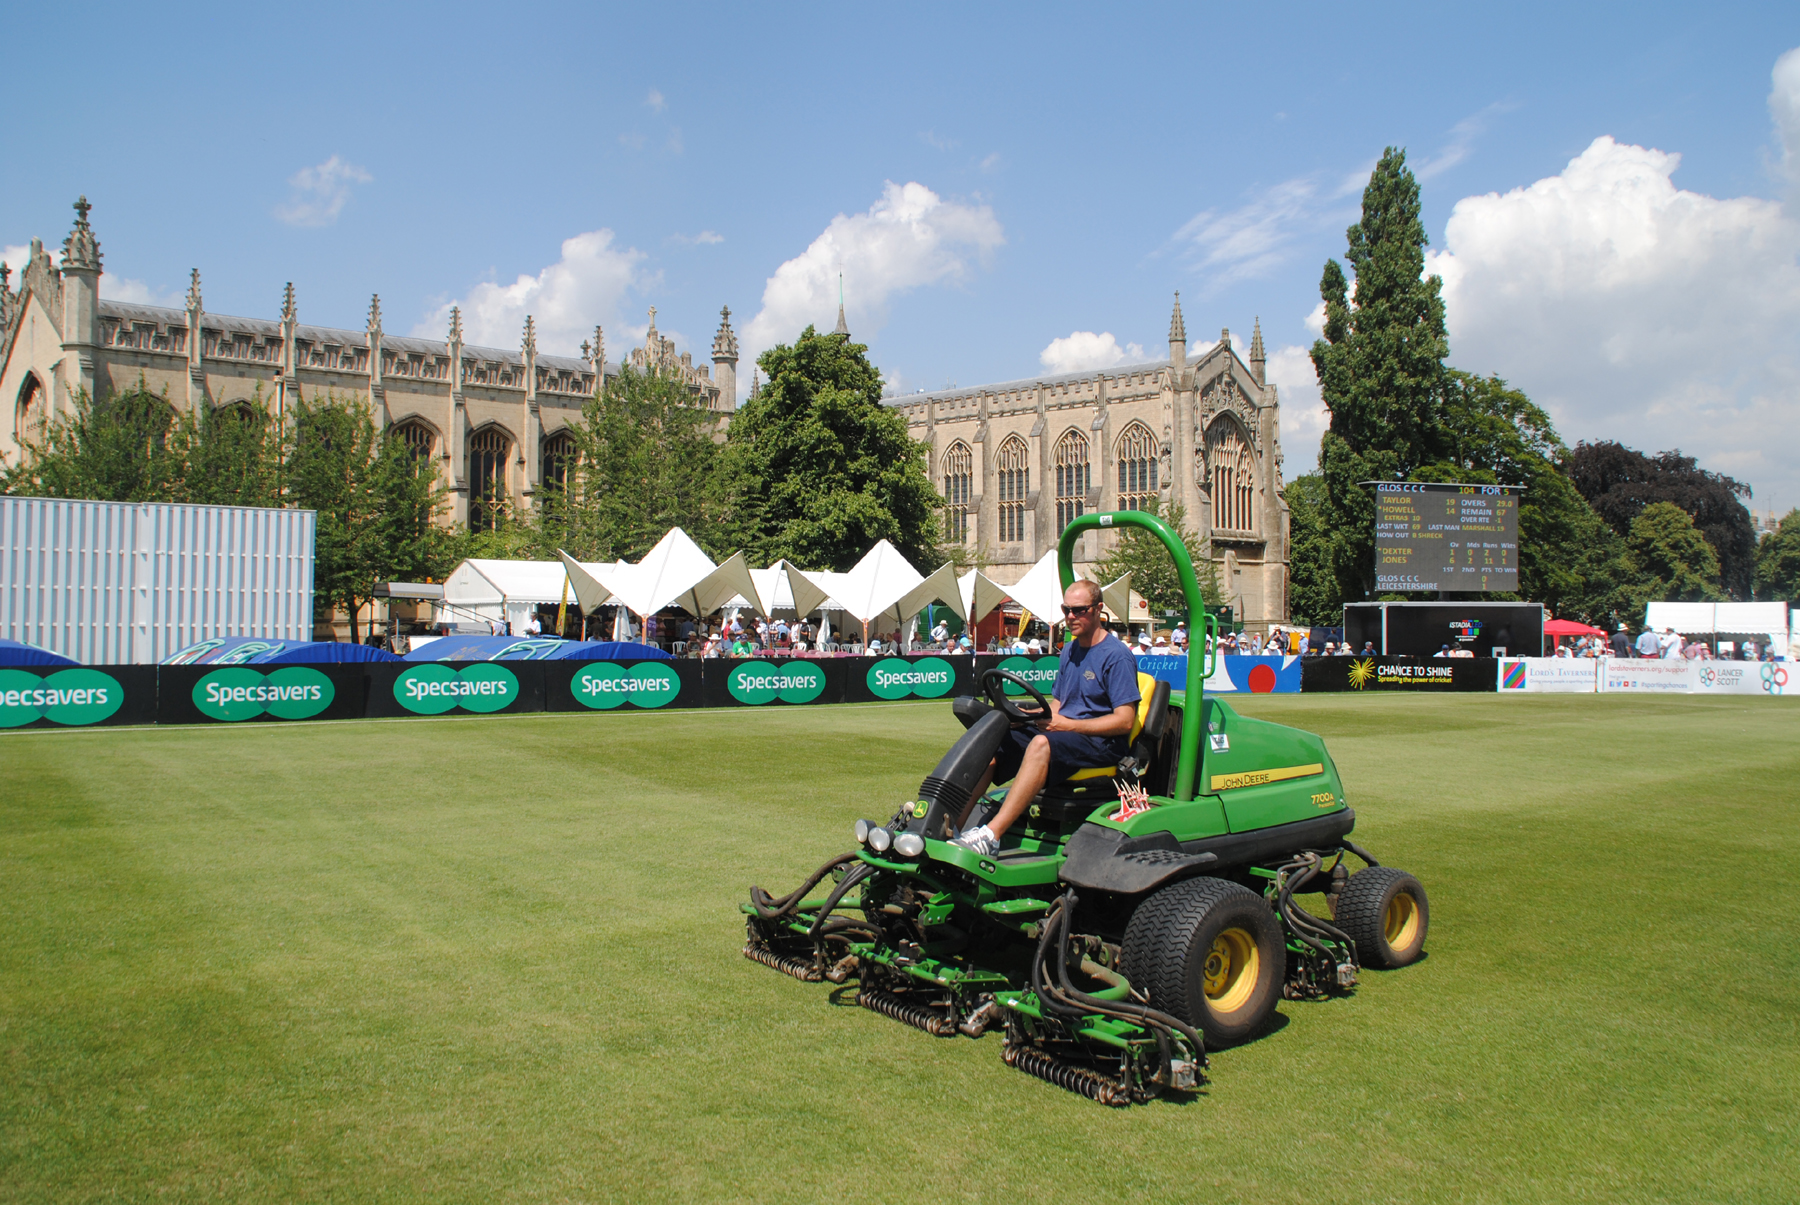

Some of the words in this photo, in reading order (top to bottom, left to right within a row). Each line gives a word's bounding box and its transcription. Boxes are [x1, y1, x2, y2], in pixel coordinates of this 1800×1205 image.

[1377, 484, 1402, 492] GLOS
[1482, 487, 1501, 495] FOR
[1382, 556, 1407, 564] JONES
[1139, 657, 1178, 670] Cricket
[1378, 665, 1412, 676] CHANCE
[1414, 666, 1426, 676] TO
[1427, 667, 1453, 677] SHINE
[1718, 669, 1743, 677] LANCER
[737, 672, 817, 691] Specsavers
[875, 669, 948, 687] Specsavers
[1378, 676, 1403, 684] Spreading
[405, 677, 508, 699] Specsavers
[581, 674, 671, 696] Specsavers
[206, 681, 322, 706] Specsavers
[1222, 777, 1244, 789] JOHN
[1244, 773, 1270, 784] DEERE
[1311, 792, 1334, 805] 7700A
